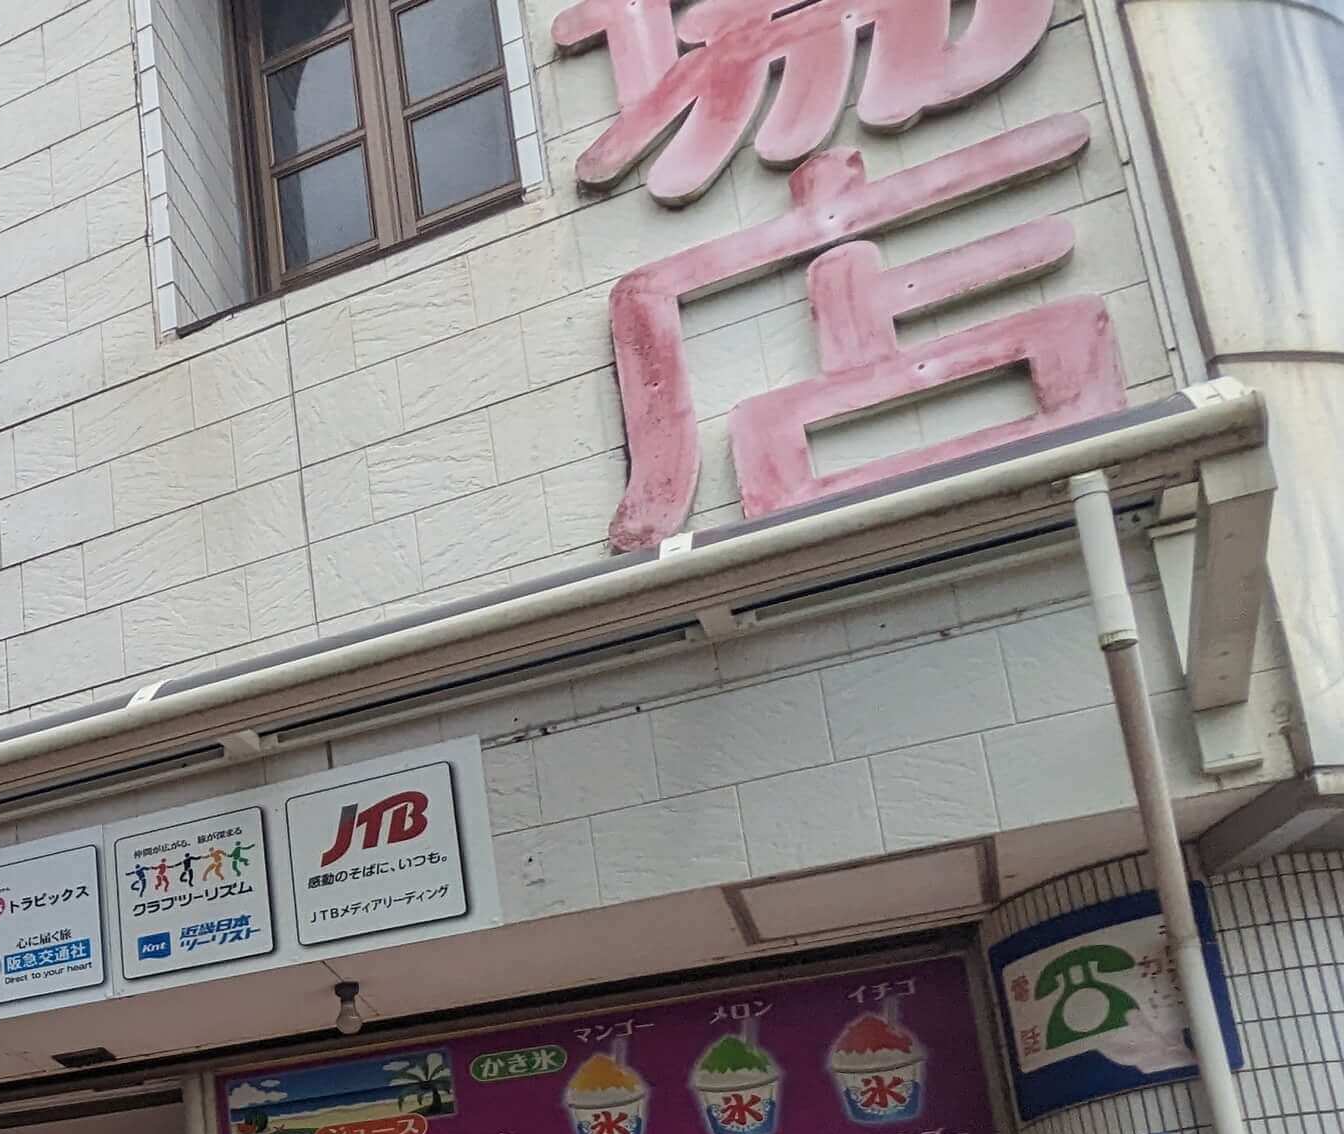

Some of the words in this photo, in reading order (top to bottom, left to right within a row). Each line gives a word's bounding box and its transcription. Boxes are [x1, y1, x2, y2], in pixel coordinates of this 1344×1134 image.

[320, 790, 429, 868] JTB
[307, 851, 449, 890] 感動のそばに、いつも。
[9, 885, 90, 914] トラピックス
[132, 881, 253, 917] クラブツーリズム
[310, 884, 450, 923] JTBメディアリーディング
[180, 914, 252, 940] 近畿日本
[180, 928, 261, 951] ツーリスト
[7, 941, 88, 972] 阪急交通社
[142, 942, 167, 953] Knt
[4, 974, 29, 985] Direct
[31, 971, 42, 980] to
[43, 967, 65, 979] your
[67, 961, 93, 973] heart
[847, 976, 917, 1003] イチゴ
[709, 1000, 773, 1024] メロン
[573, 1019, 655, 1042] マンゴー
[479, 1047, 559, 1078] かき氷
[861, 1074, 907, 1110] 氷
[719, 1092, 765, 1127] 氷
